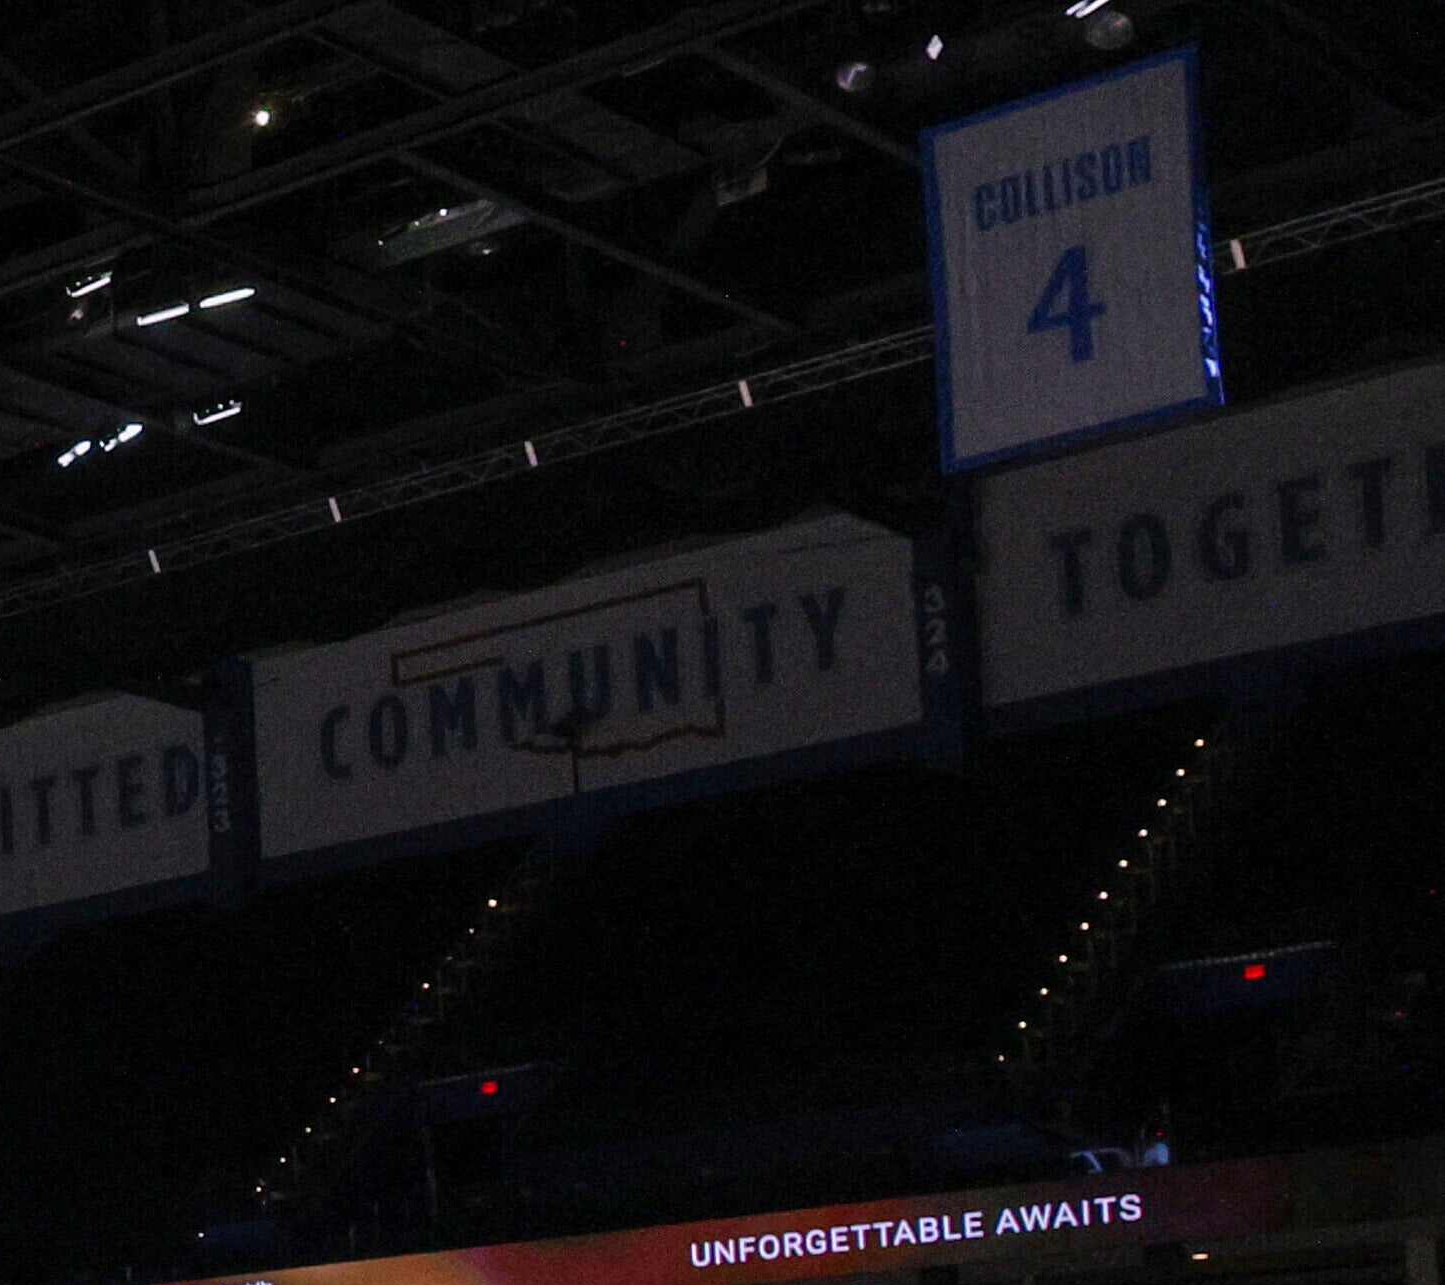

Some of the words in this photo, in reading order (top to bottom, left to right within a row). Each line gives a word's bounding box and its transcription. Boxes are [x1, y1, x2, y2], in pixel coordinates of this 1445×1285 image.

[974, 137, 1152, 232] COLLISON
[1027, 244, 1107, 362] 4
[321, 587, 847, 780] COMMUNITY
[690, 1211, 985, 1267] UNFORGETTABLE
[996, 1194, 1143, 1236] AWAITS
